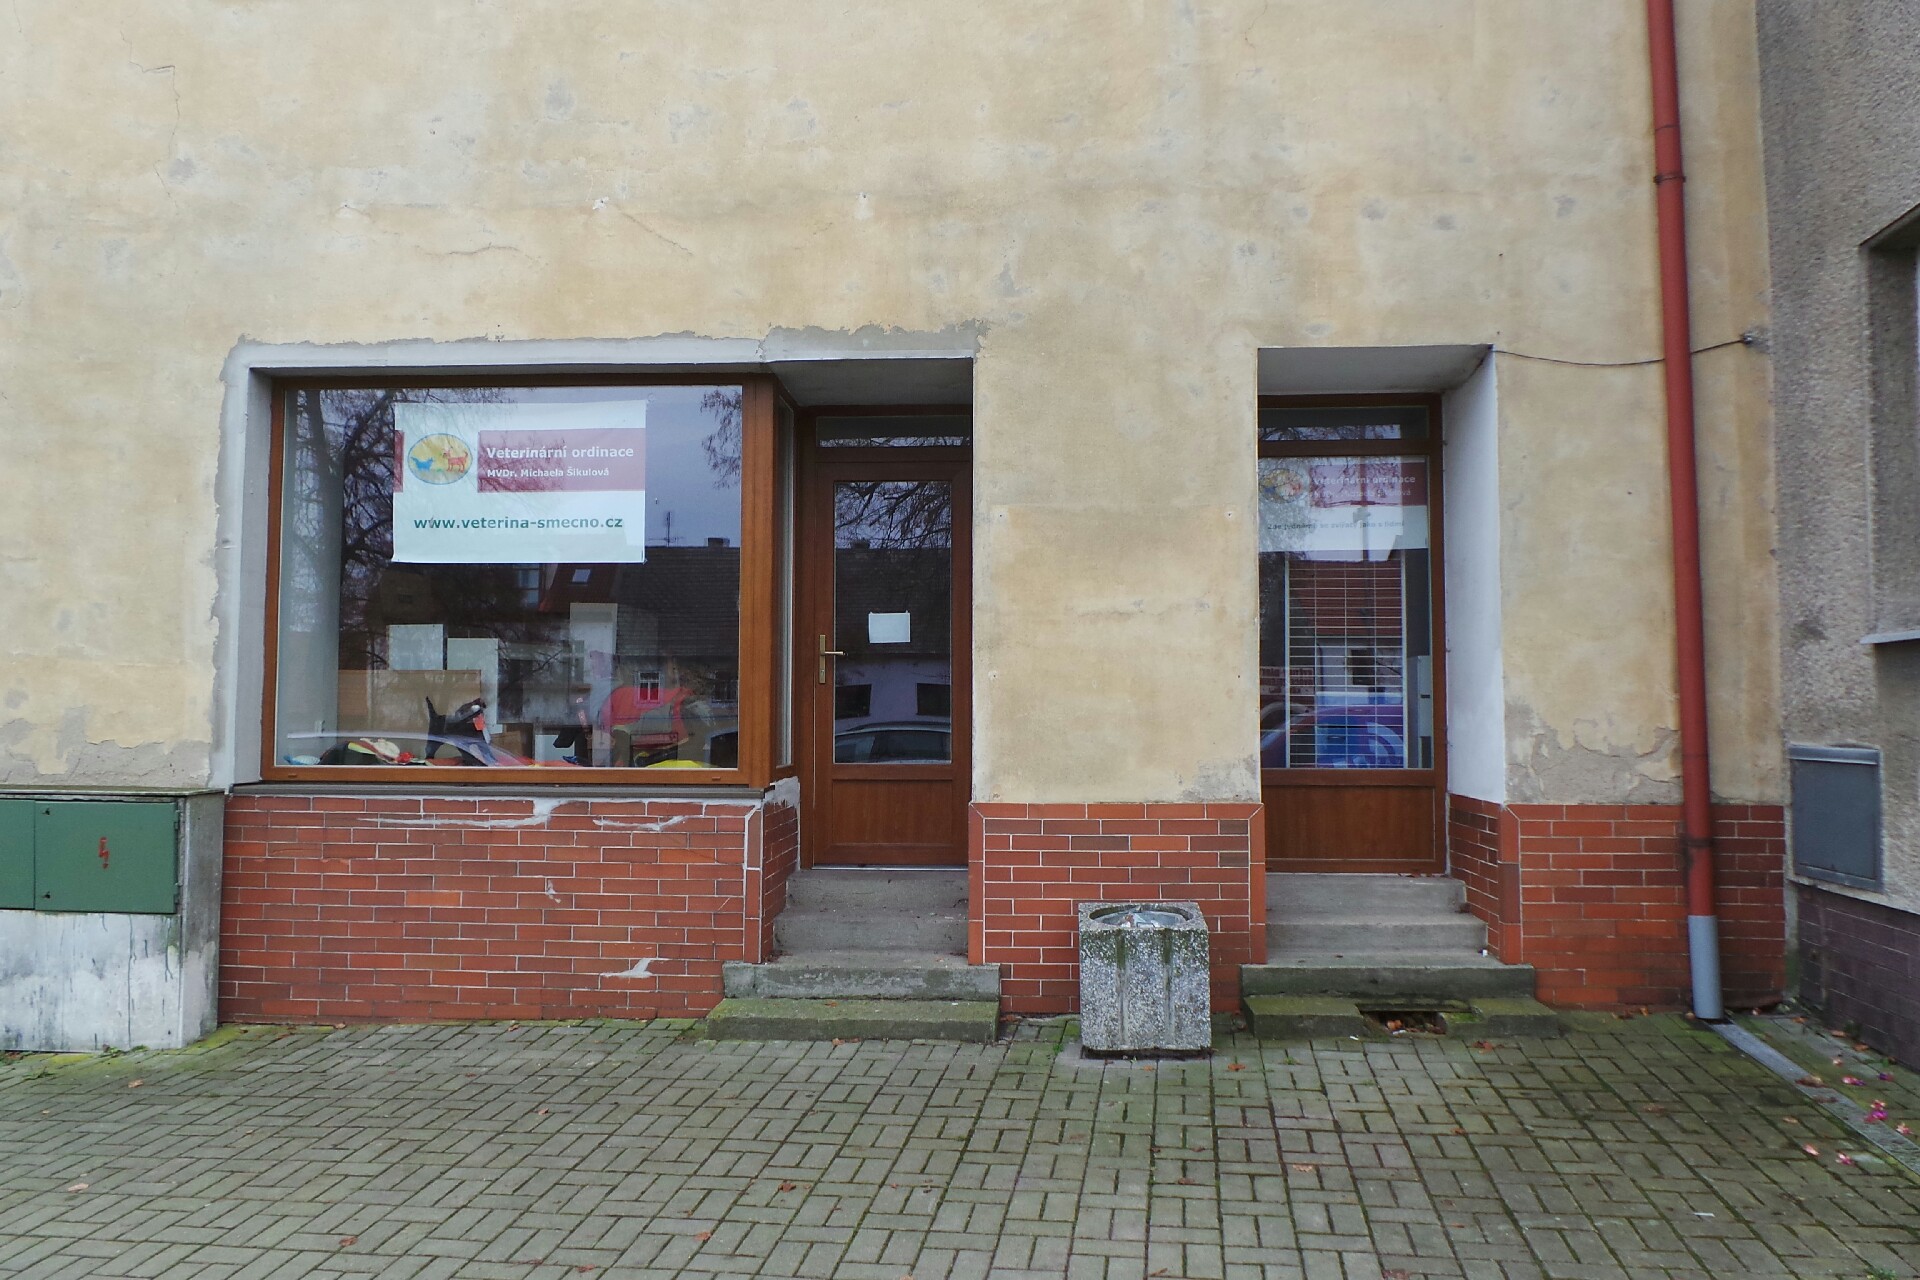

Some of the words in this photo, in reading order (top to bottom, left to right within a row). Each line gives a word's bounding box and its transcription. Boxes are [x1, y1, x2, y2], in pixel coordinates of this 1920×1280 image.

[486, 445, 567, 459] Veterinární
[572, 445, 634, 458] ordinace
[487, 468, 518, 478] MVDr.
[520, 467, 564, 477] Michaela
[413, 515, 623, 530] www.veterina-smecno.cz
